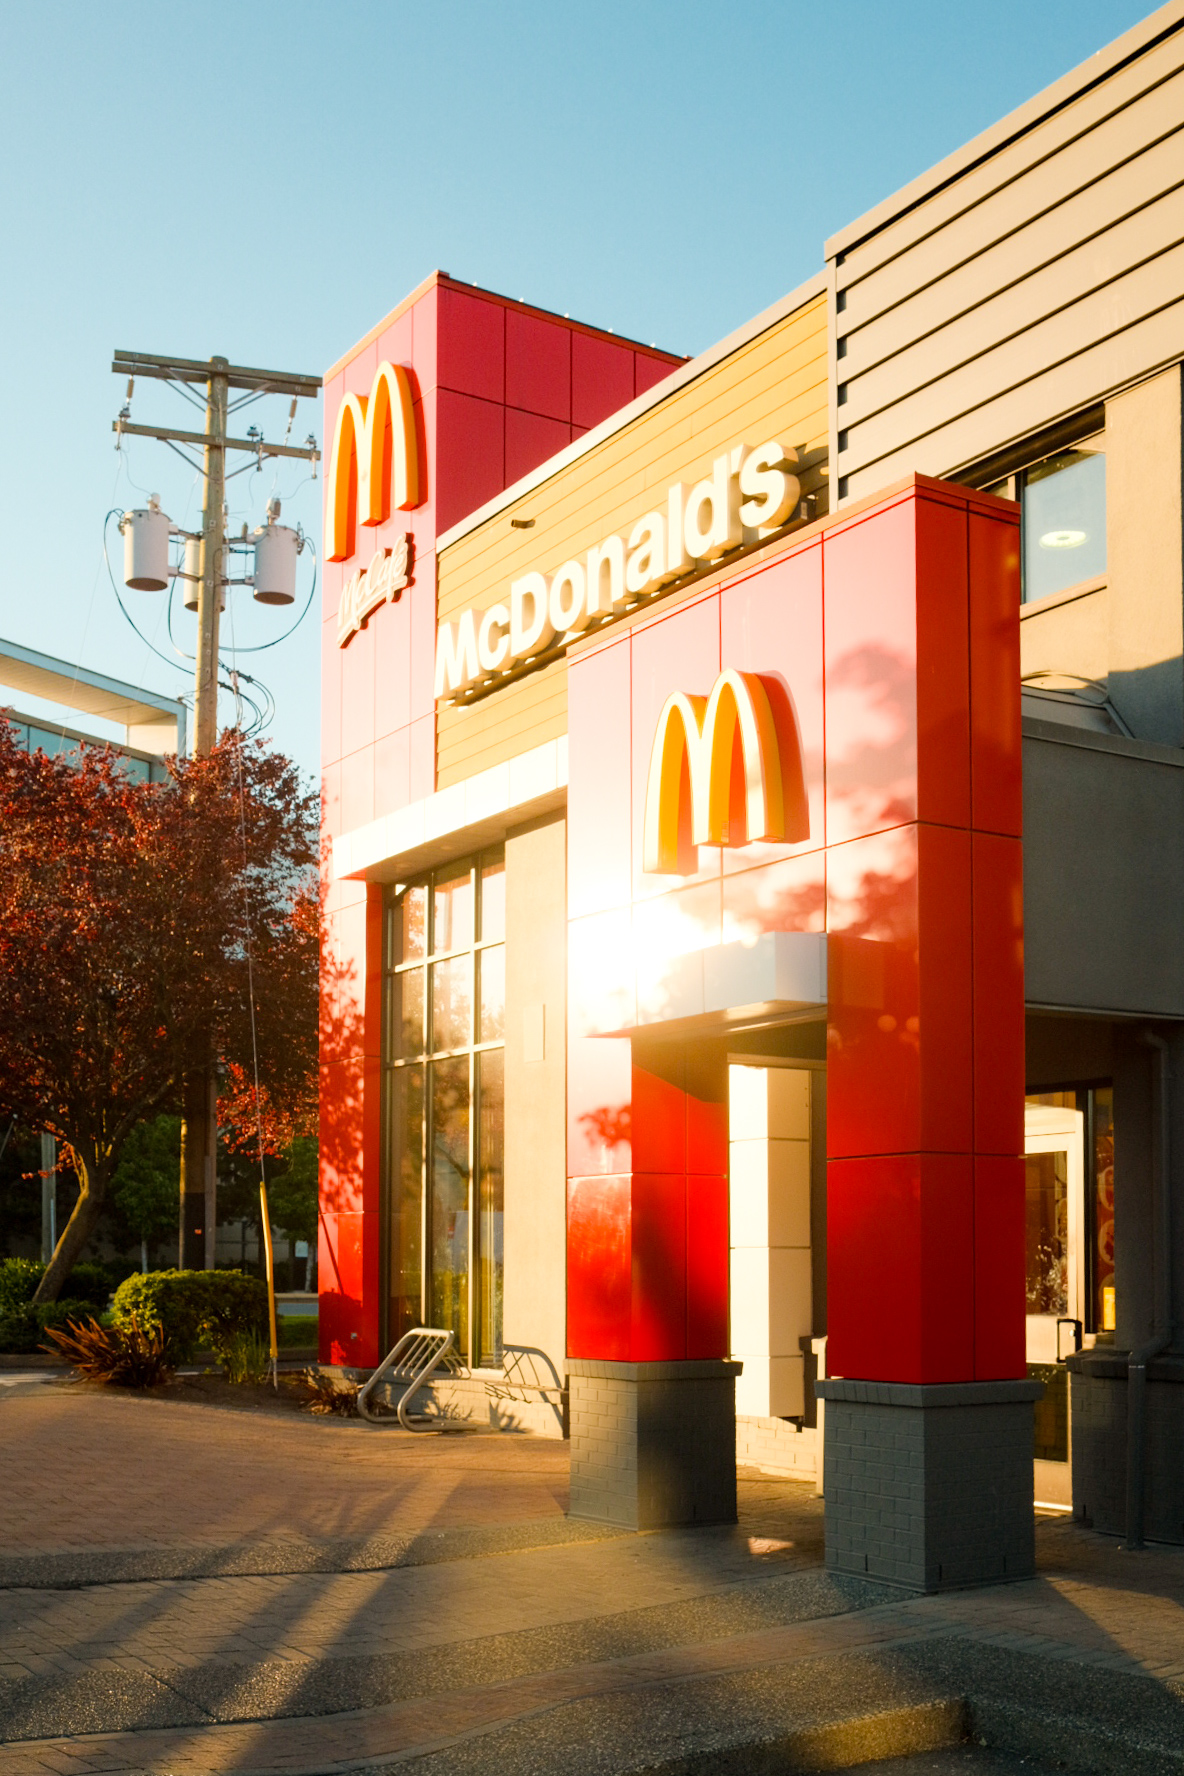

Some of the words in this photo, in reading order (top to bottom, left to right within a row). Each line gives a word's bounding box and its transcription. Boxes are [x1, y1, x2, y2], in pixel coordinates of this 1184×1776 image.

[325, 360, 420, 563] M
[434, 441, 797, 701] McDonald's
[643, 667, 787, 875] M
